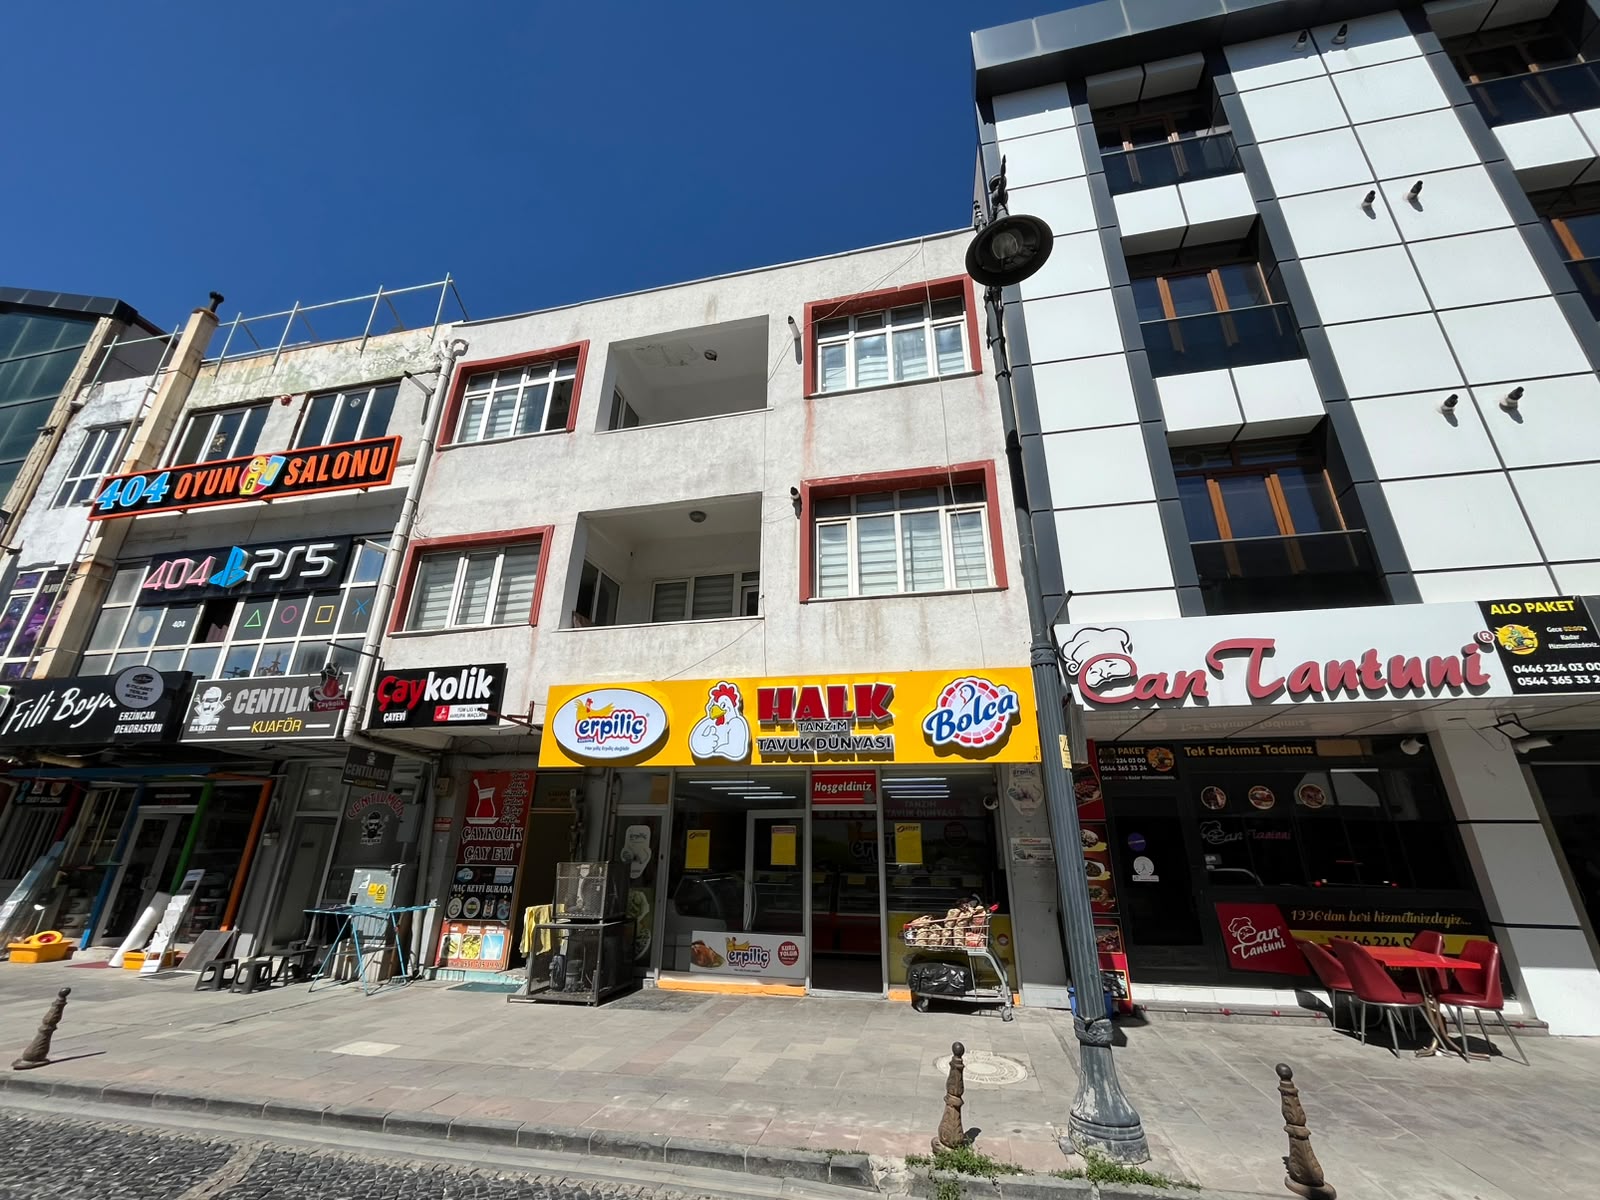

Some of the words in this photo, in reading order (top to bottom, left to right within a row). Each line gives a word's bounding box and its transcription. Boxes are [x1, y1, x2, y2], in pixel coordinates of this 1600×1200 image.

[97, 472, 170, 510] 404
[174, 466, 240, 499] OYUN
[284, 446, 389, 486] SALONU
[142, 555, 216, 590] 404
[246, 543, 338, 582] PS5
[1490, 603, 1522, 615] ALO
[1524, 600, 1575, 613] PAKET
[172, 620, 186, 629] 404
[1205, 638, 1492, 699] Tantuni
[1512, 664, 1544, 674] 0446
[1544, 663, 1567, 673] 224
[1568, 662, 1585, 672] 03
[1586, 662, 1600, 671] 00
[377, 667, 493, 712] Çaykolik
[1517, 676, 1548, 686] 0544
[1551, 676, 1573, 684] 365
[1574, 675, 1591, 684] 33
[232, 685, 311, 714] CENTILM
[757, 682, 895, 721] HALK
[1, 690, 55, 735] Filli
[52, 687, 117, 729] Boya
[926, 695, 1014, 741] Bolca
[114, 724, 163, 734] DEKORASYON
[251, 717, 302, 734] KUAFÖR
[578, 714, 644, 740] erpiliç
[758, 738, 812, 751] TAVUK
[816, 734, 893, 750] DÜNYASI
[1184, 746, 1206, 757] Tek
[1208, 745, 1261, 756] Farkımız
[1262, 744, 1314, 755] Tadımız
[814, 781, 872, 794] Hoşgeldiniz
[462, 824, 524, 844] ÇAYKOLİK
[464, 846, 492, 864] ÇAY
[491, 844, 514, 860] EVİ
[486, 884, 513, 894] BURADA
[1290, 910, 1346, 922] 1996'dan
[1349, 910, 1371, 922] beri
[729, 948, 768, 965] erpiliç
[1232, 938, 1286, 959] Tantuni
